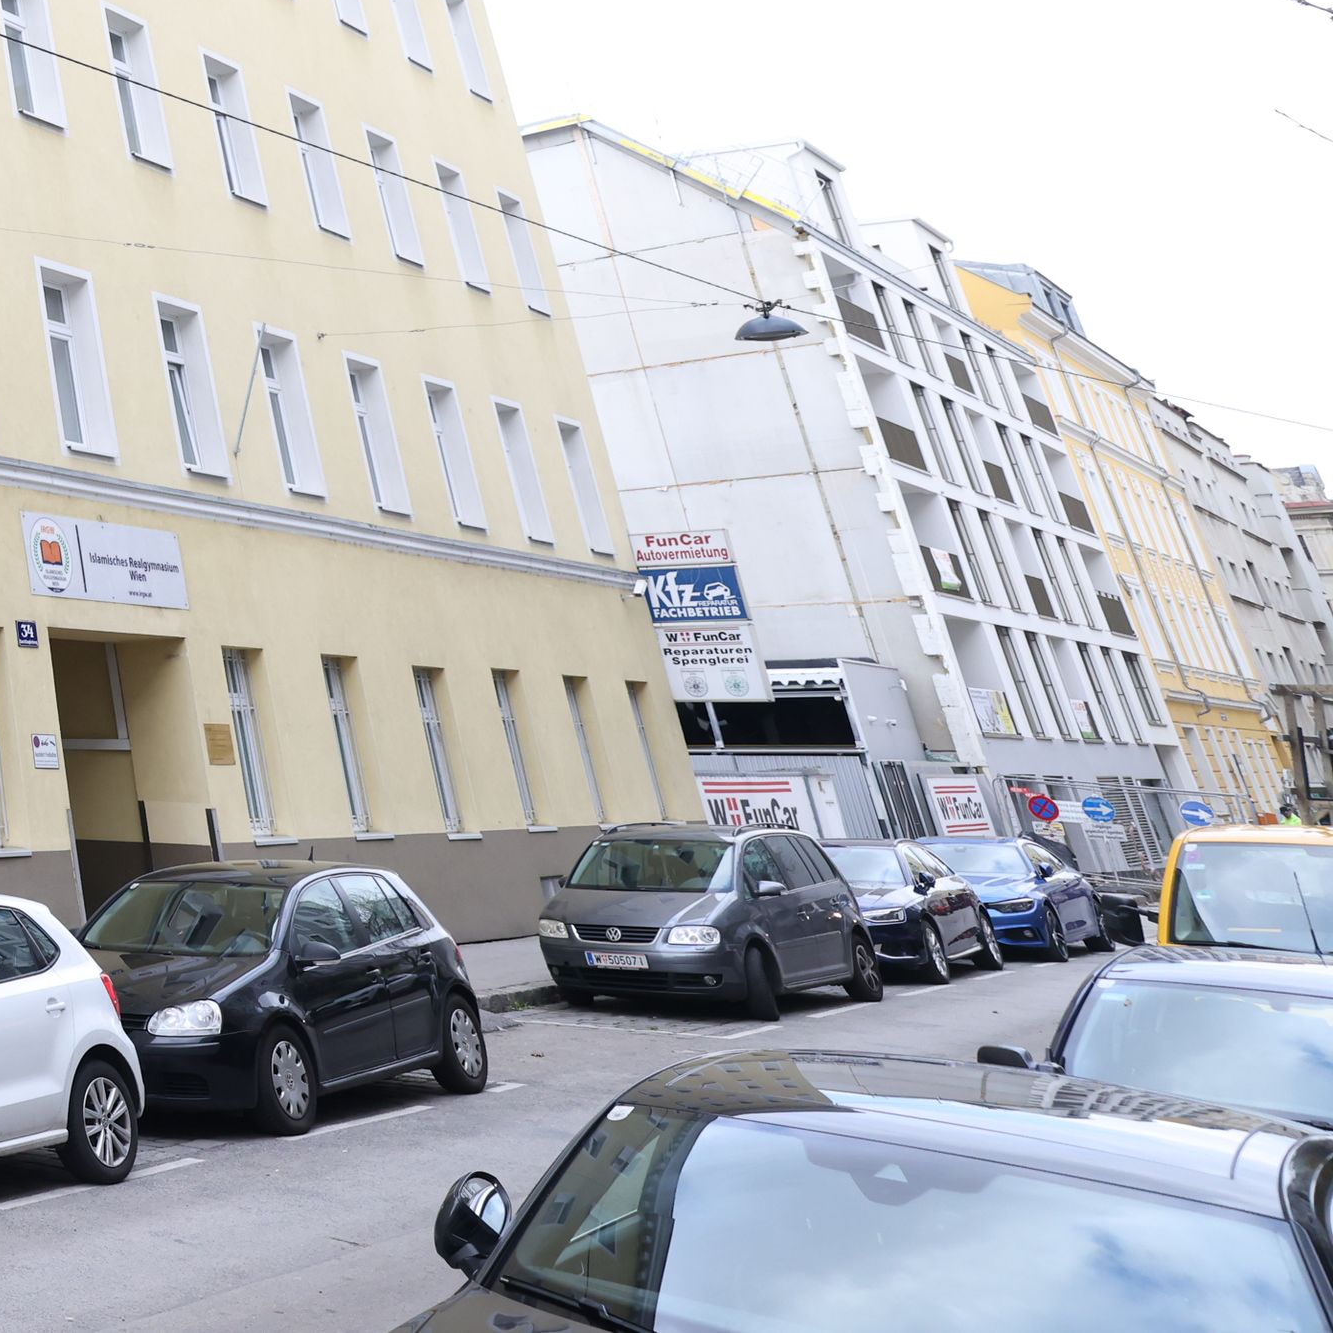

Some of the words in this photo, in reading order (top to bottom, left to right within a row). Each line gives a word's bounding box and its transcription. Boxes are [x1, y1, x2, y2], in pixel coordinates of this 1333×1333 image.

[645, 534, 711, 547] FunCar
[637, 547, 729, 561] Autovermietung
[89, 552, 128, 567] Islamisches
[129, 557, 179, 573] Realgymnasium
[129, 570, 147, 582] Wien
[653, 607, 741, 618] FACHBETRIEB
[21, 624, 34, 638] 34
[694, 631, 741, 642] FunCar
[663, 647, 752, 657] Reparaturen
[672, 655, 749, 666] Spenglerei
[740, 798, 799, 827] FunCar
[952, 796, 984, 820] FunCar
